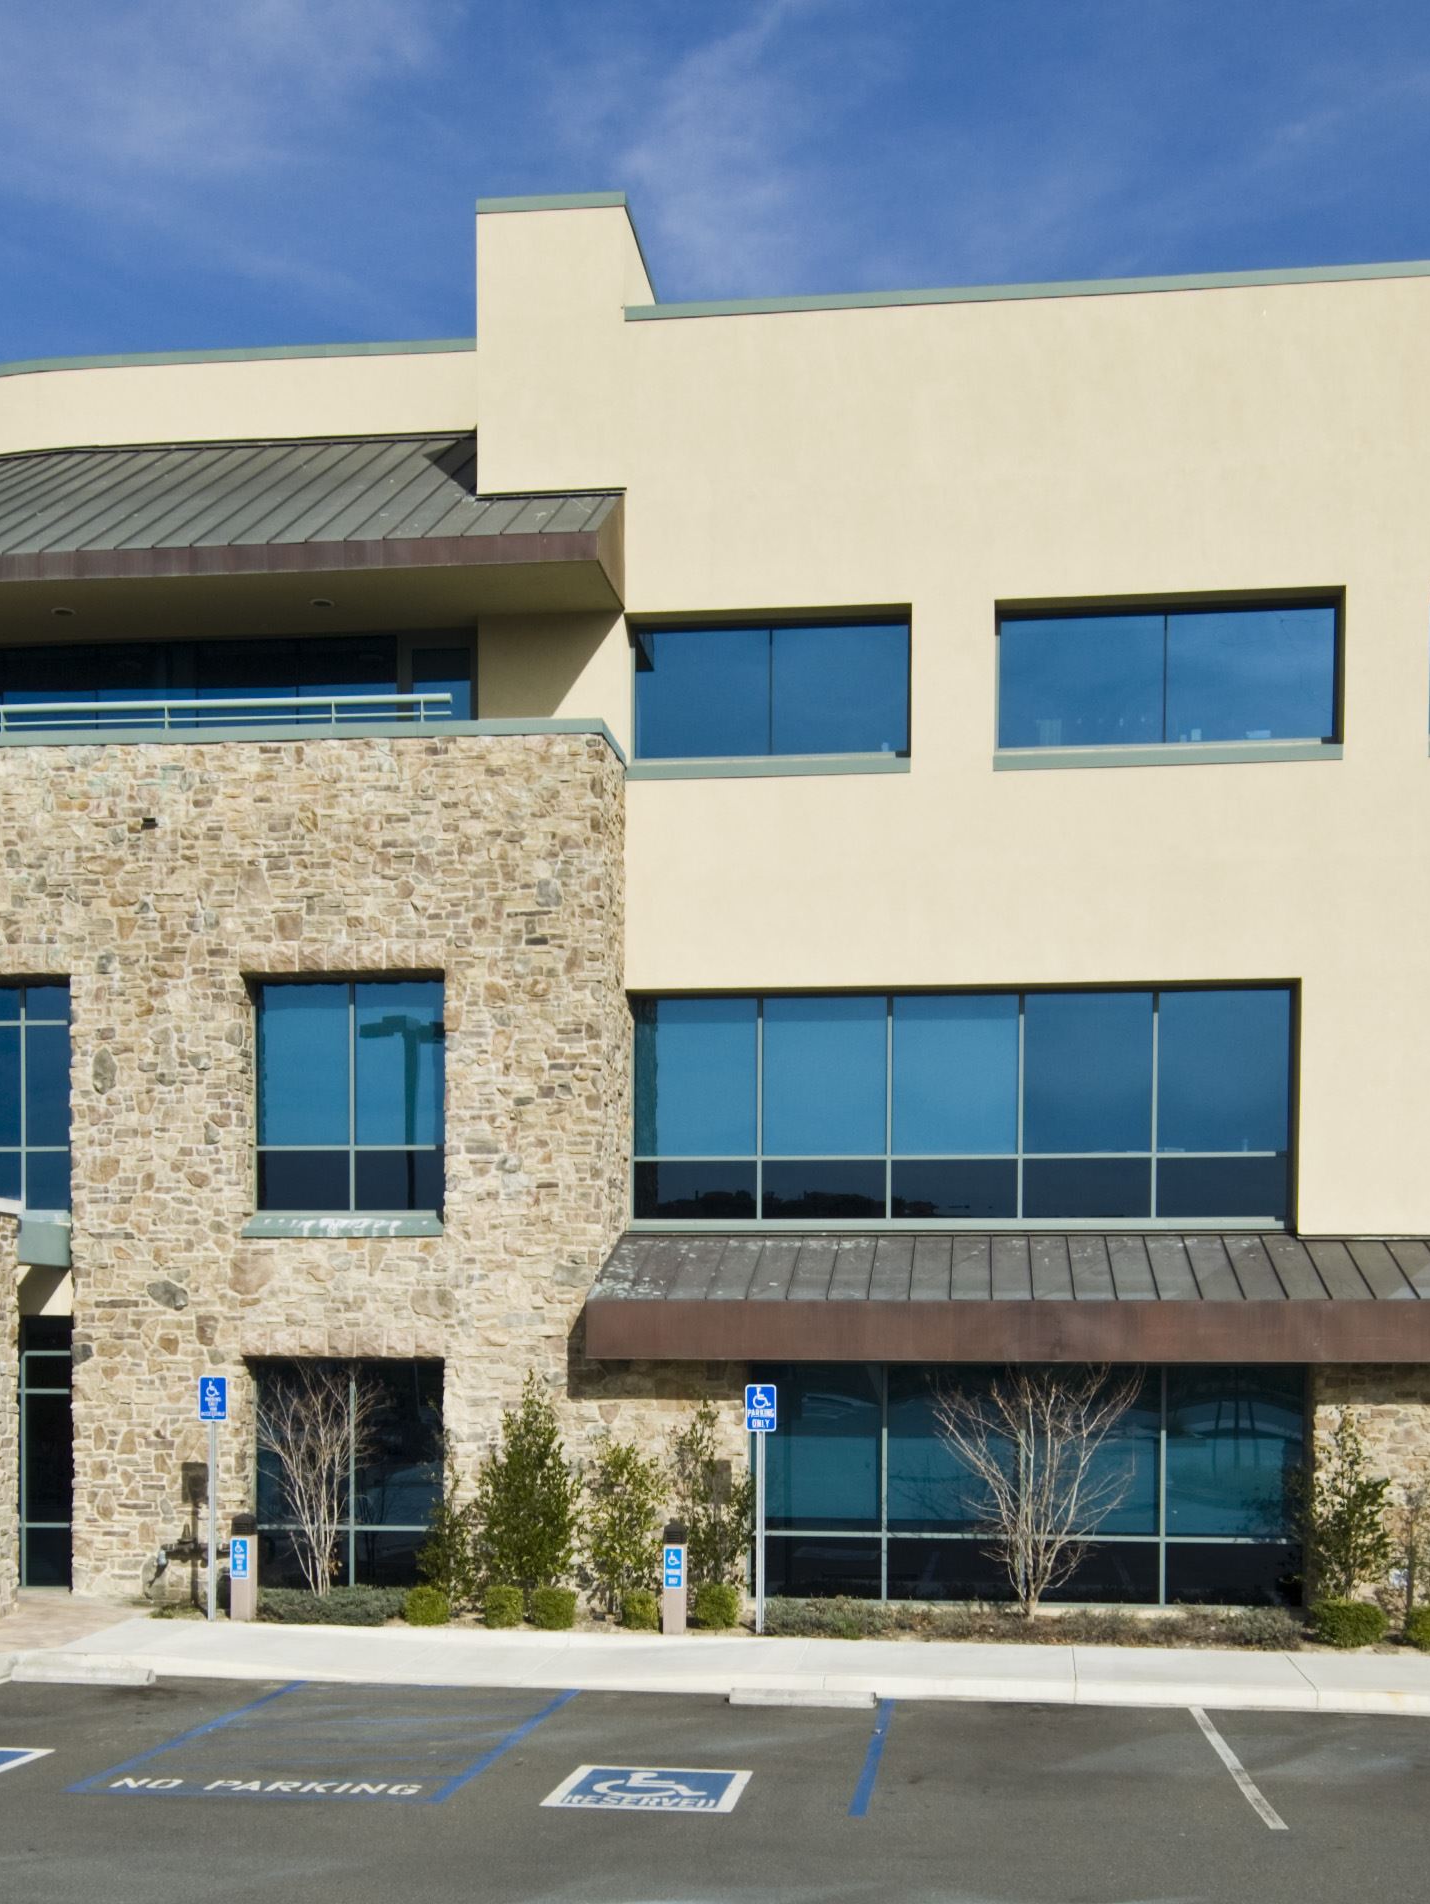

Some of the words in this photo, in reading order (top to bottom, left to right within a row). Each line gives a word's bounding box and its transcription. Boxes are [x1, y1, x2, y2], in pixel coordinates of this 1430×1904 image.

[747, 1408, 775, 1418] PARKING
[751, 1418, 770, 1429] ONLY
[108, 1777, 184, 1789] NO
[202, 1779, 423, 1796] PARKING
[561, 1794, 717, 1808] RESERVED
